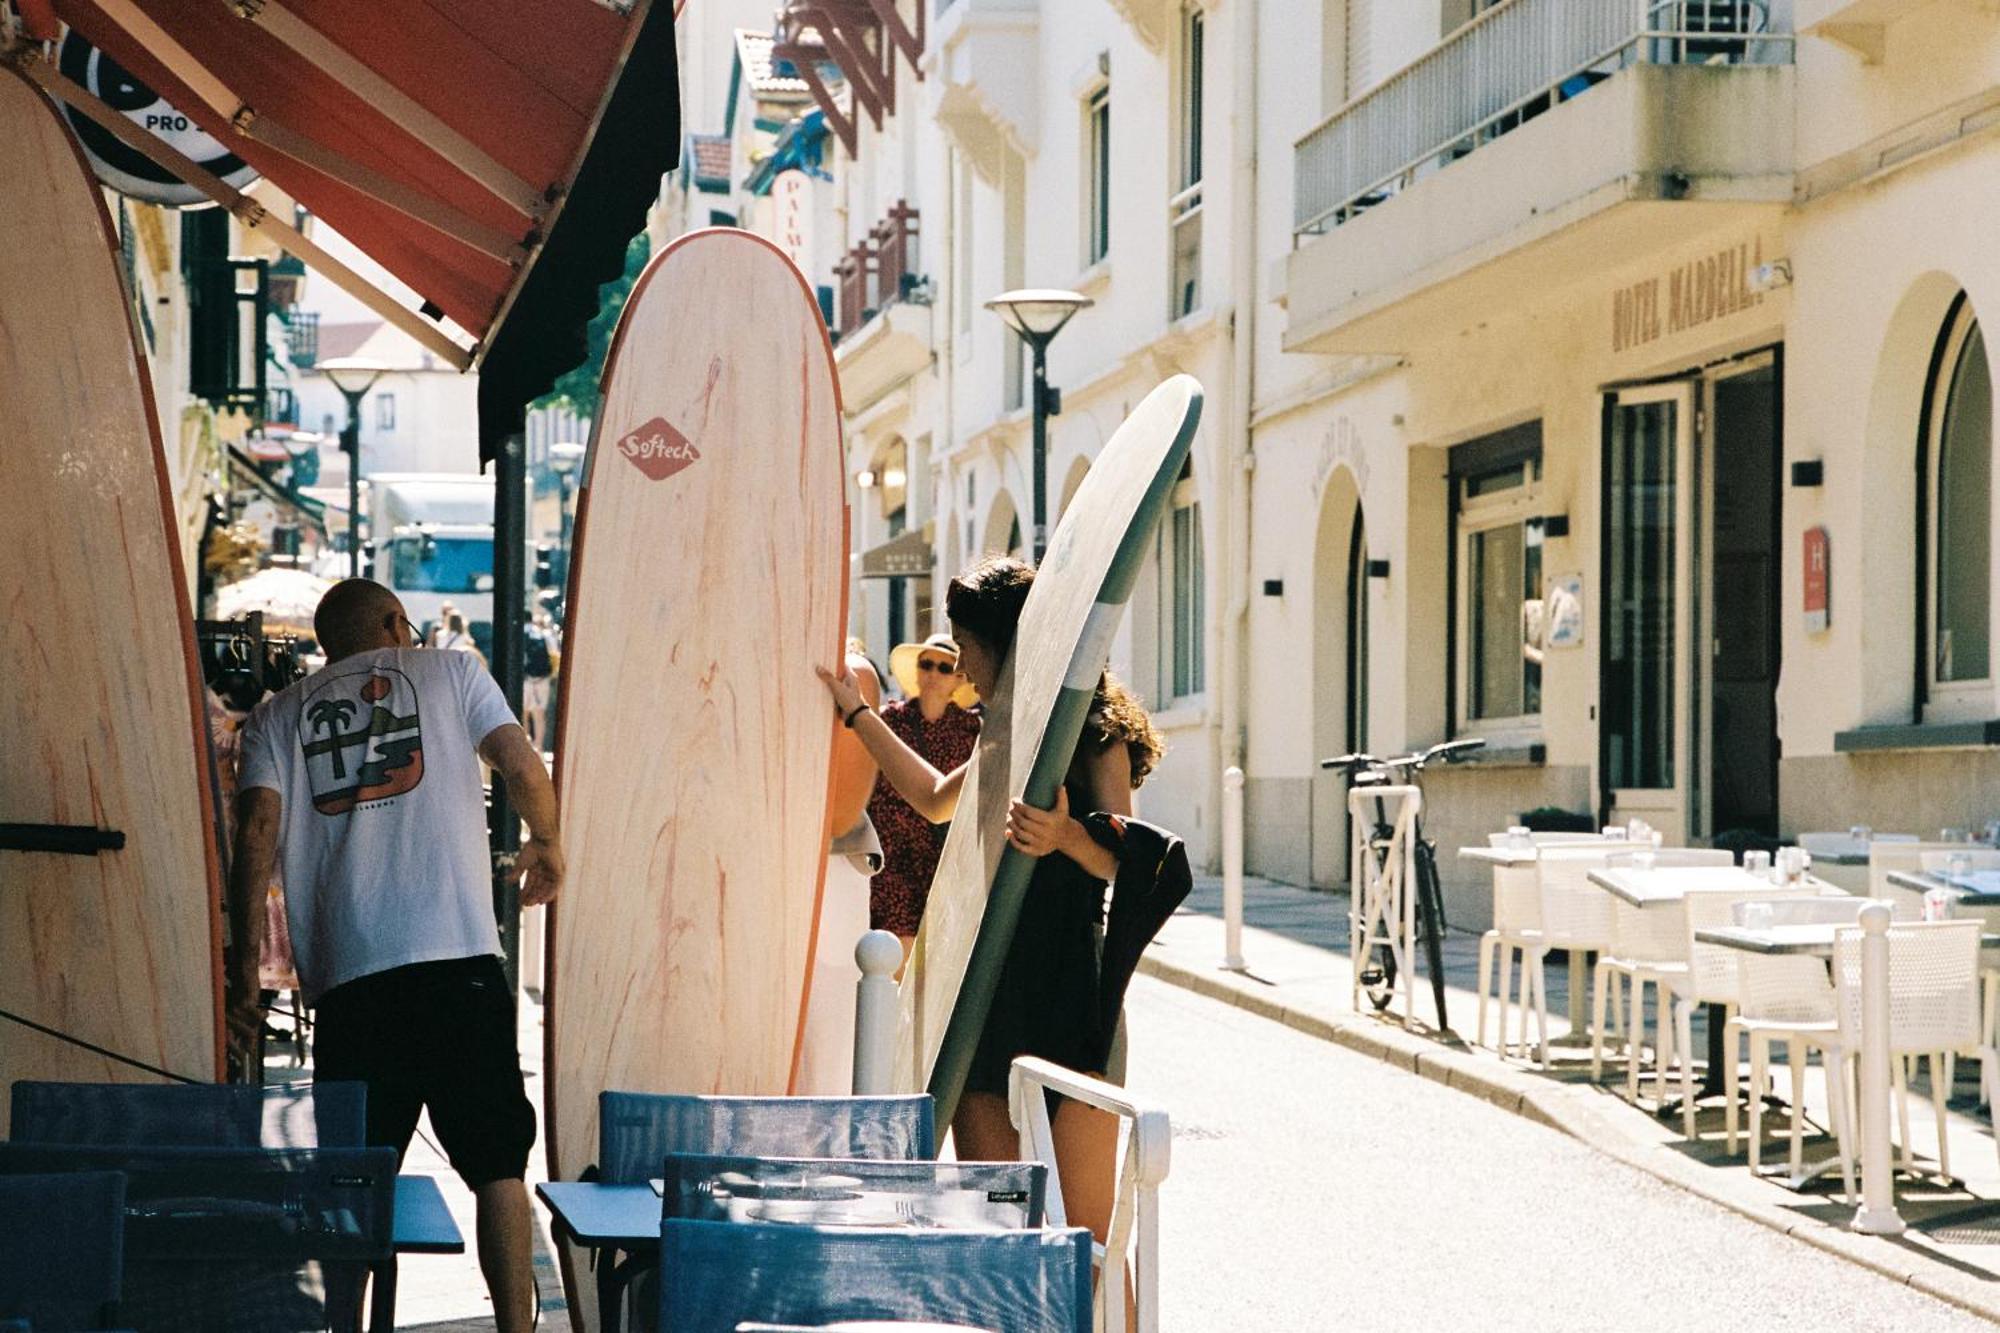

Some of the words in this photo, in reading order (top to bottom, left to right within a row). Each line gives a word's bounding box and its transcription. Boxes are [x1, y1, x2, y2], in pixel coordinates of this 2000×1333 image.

[146, 113, 189, 132] PRO
[1612, 277, 1661, 353] HOTEL
[617, 433, 697, 461] Softech
